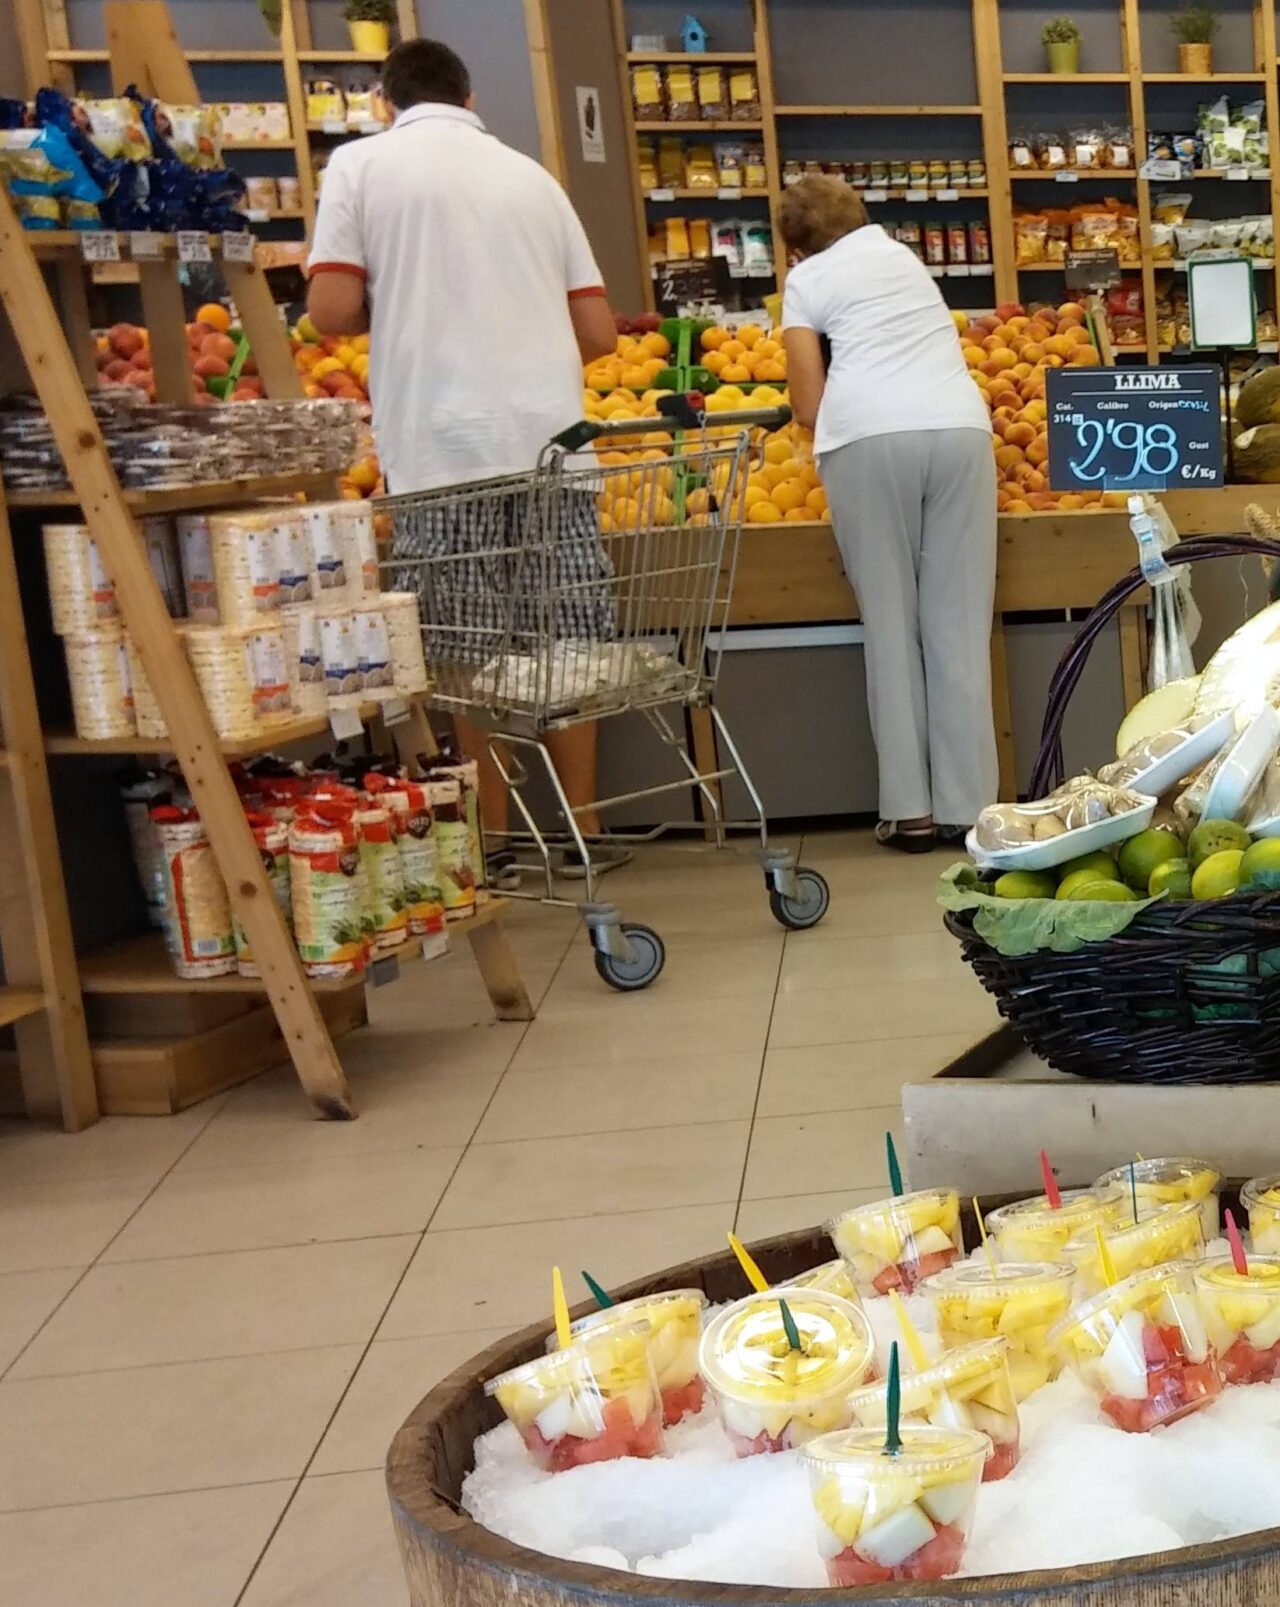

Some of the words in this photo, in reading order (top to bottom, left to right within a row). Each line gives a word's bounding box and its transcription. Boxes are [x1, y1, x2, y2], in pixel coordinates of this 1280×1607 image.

[1114, 374, 1181, 390] LLIMA
[1056, 402, 1074, 411] Cat.
[1097, 402, 1129, 410] Calibre
[1149, 401, 1178, 411] Origen
[1054, 414, 1071, 424] 314
[1069, 418, 1179, 481] 2'98
[1189, 441, 1209, 450] Gust
[1181, 464, 1216, 480] €/Kg
